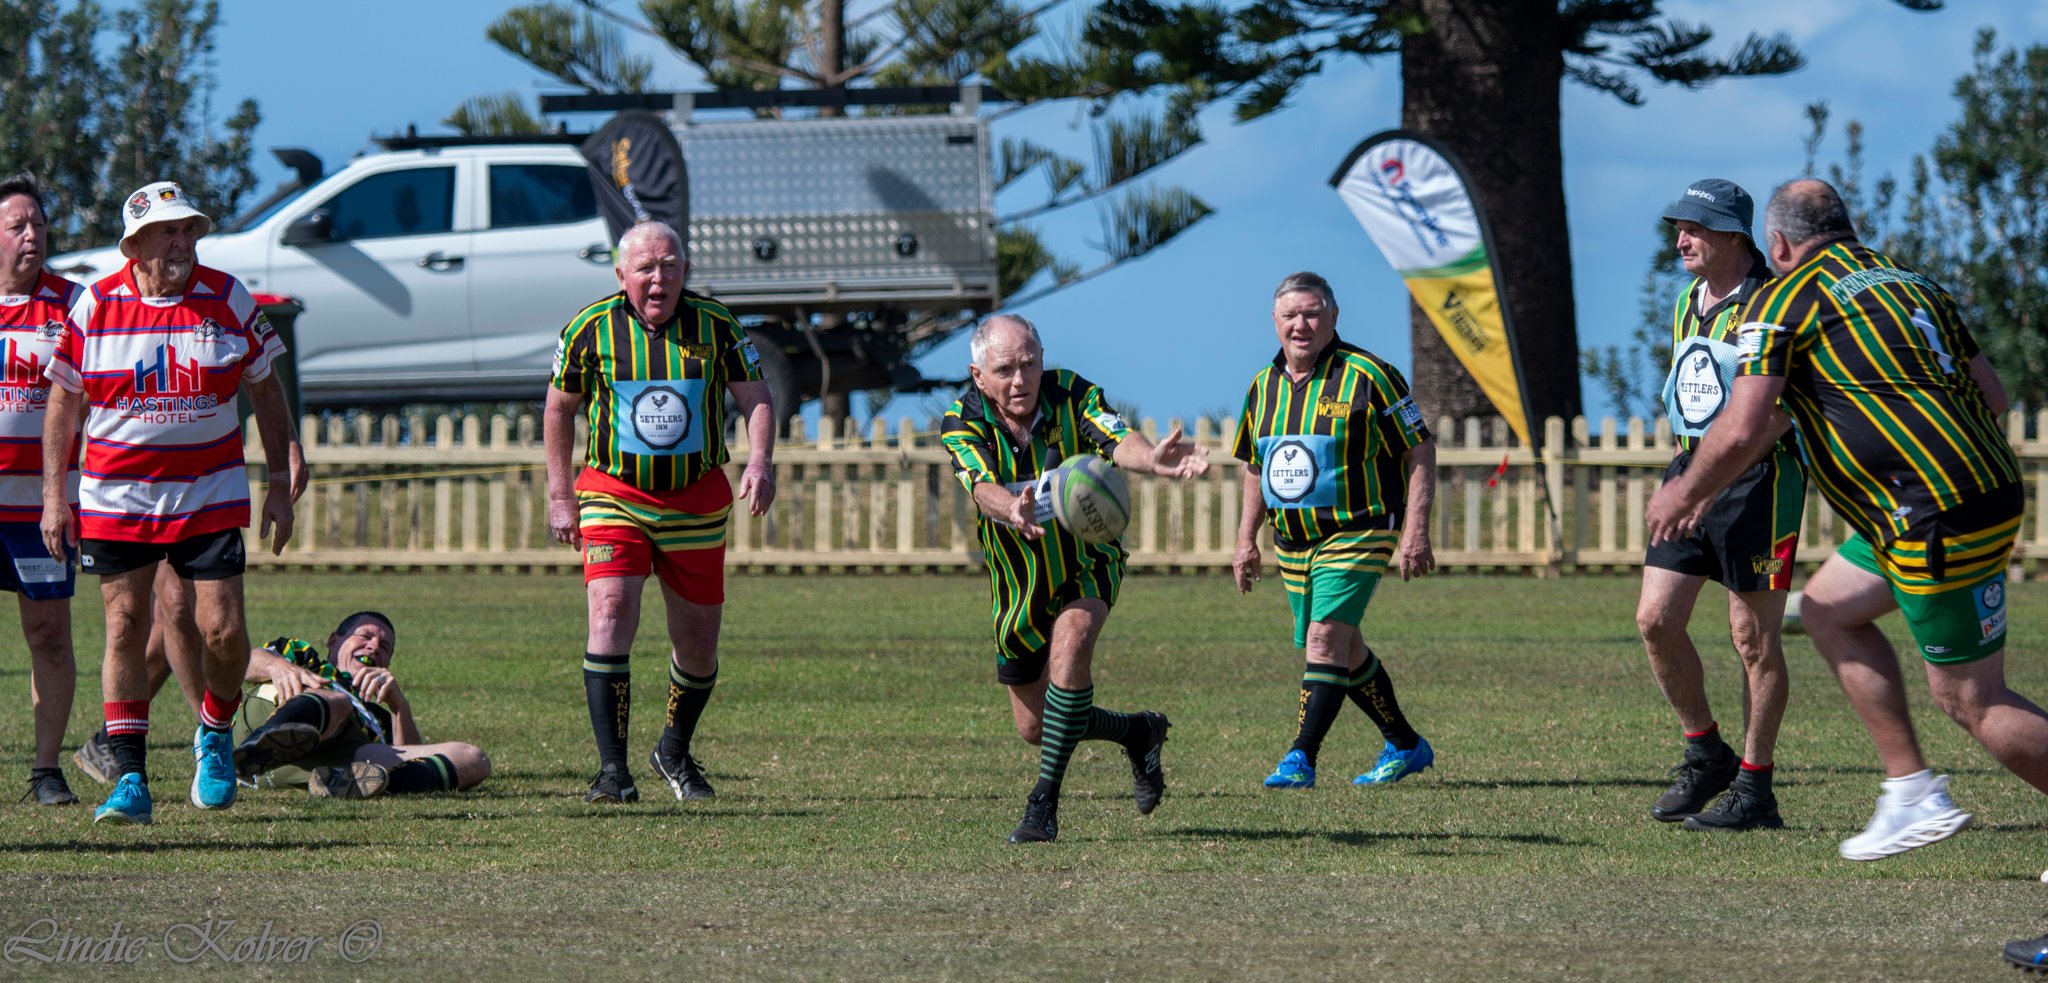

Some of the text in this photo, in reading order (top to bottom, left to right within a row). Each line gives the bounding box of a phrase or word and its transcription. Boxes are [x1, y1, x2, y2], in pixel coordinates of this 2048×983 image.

[1681, 382, 1720, 396] SETTLERS
[115, 393, 218, 412] HASTINGS
[1690, 394, 1701, 403] INN
[143, 413, 198, 425] HOTEL
[639, 414, 683, 424] SETTLERS
[1272, 469, 1309, 478] SETTLERS
